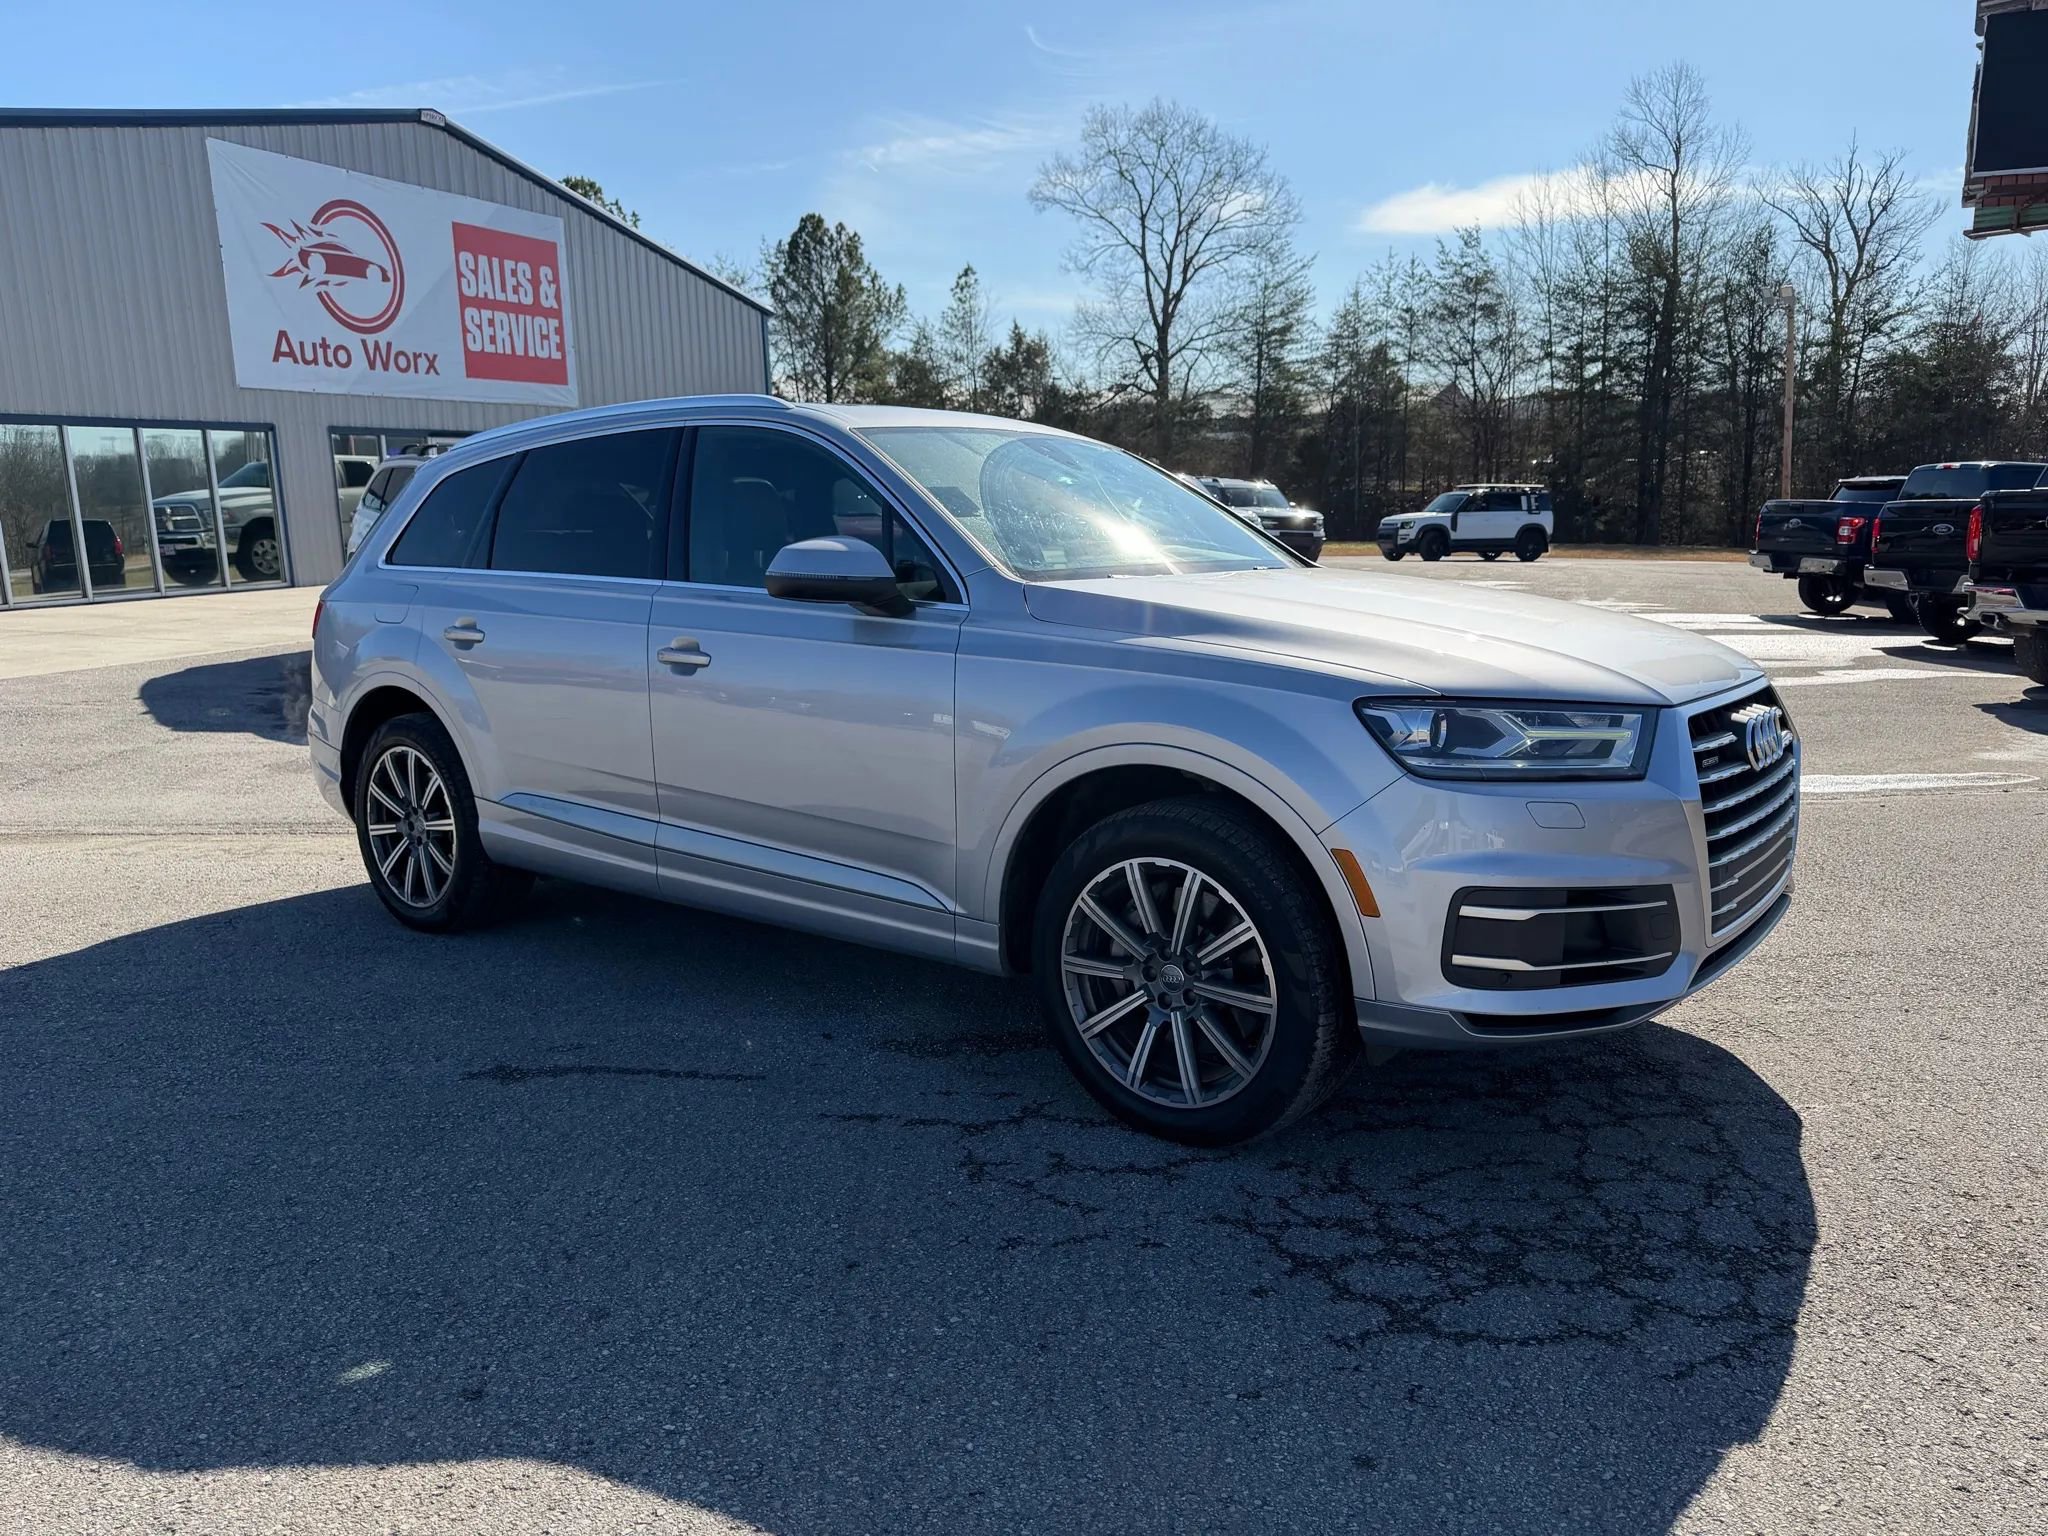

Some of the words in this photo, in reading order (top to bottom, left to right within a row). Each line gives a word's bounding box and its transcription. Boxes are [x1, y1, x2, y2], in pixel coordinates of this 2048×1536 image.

[458, 251, 533, 305] SALES
[539, 265, 559, 309] &
[272, 329, 353, 369] Auto
[360, 338, 440, 376] Worx
[464, 307, 562, 360] SERVICE
